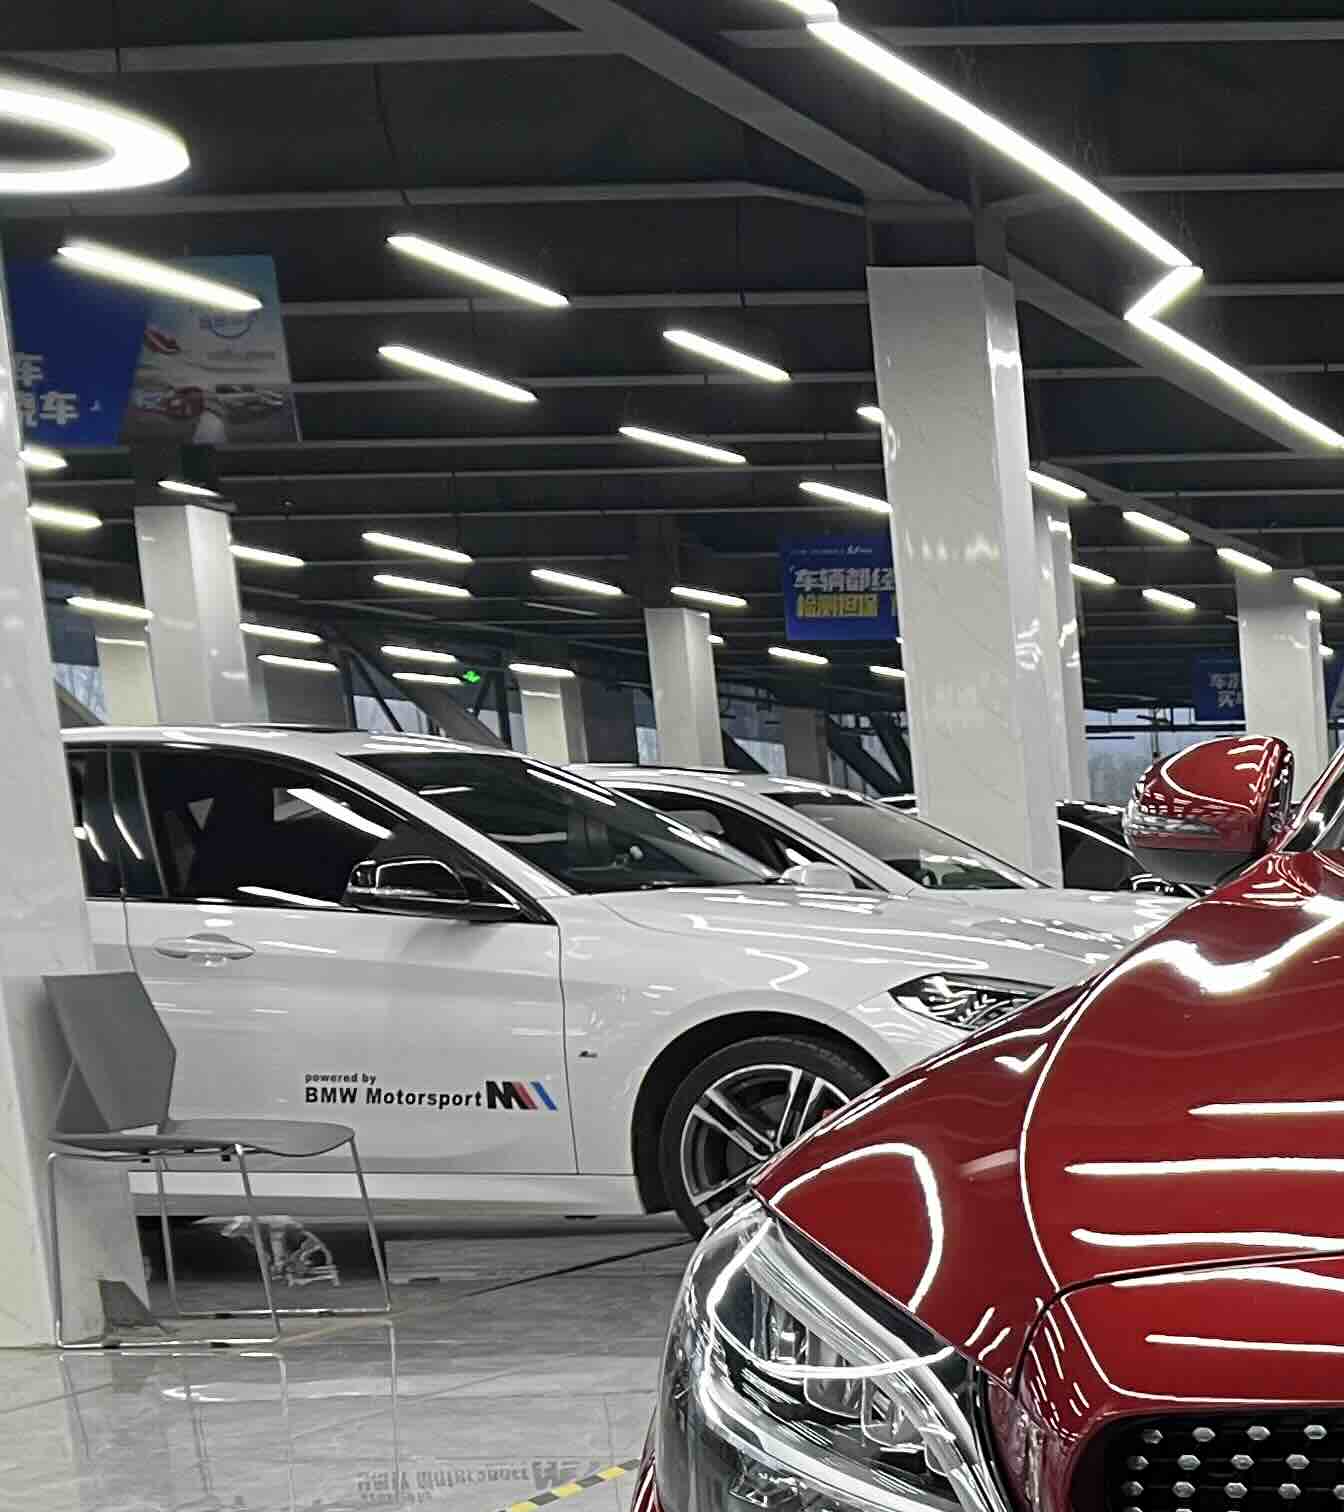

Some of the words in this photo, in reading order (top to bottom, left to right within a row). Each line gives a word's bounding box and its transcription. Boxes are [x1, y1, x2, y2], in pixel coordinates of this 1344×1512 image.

[305, 1073, 358, 1083] powered
[361, 1073, 377, 1085] by
[305, 1087, 358, 1105] BMW
[365, 1087, 483, 1110] Motorsport
